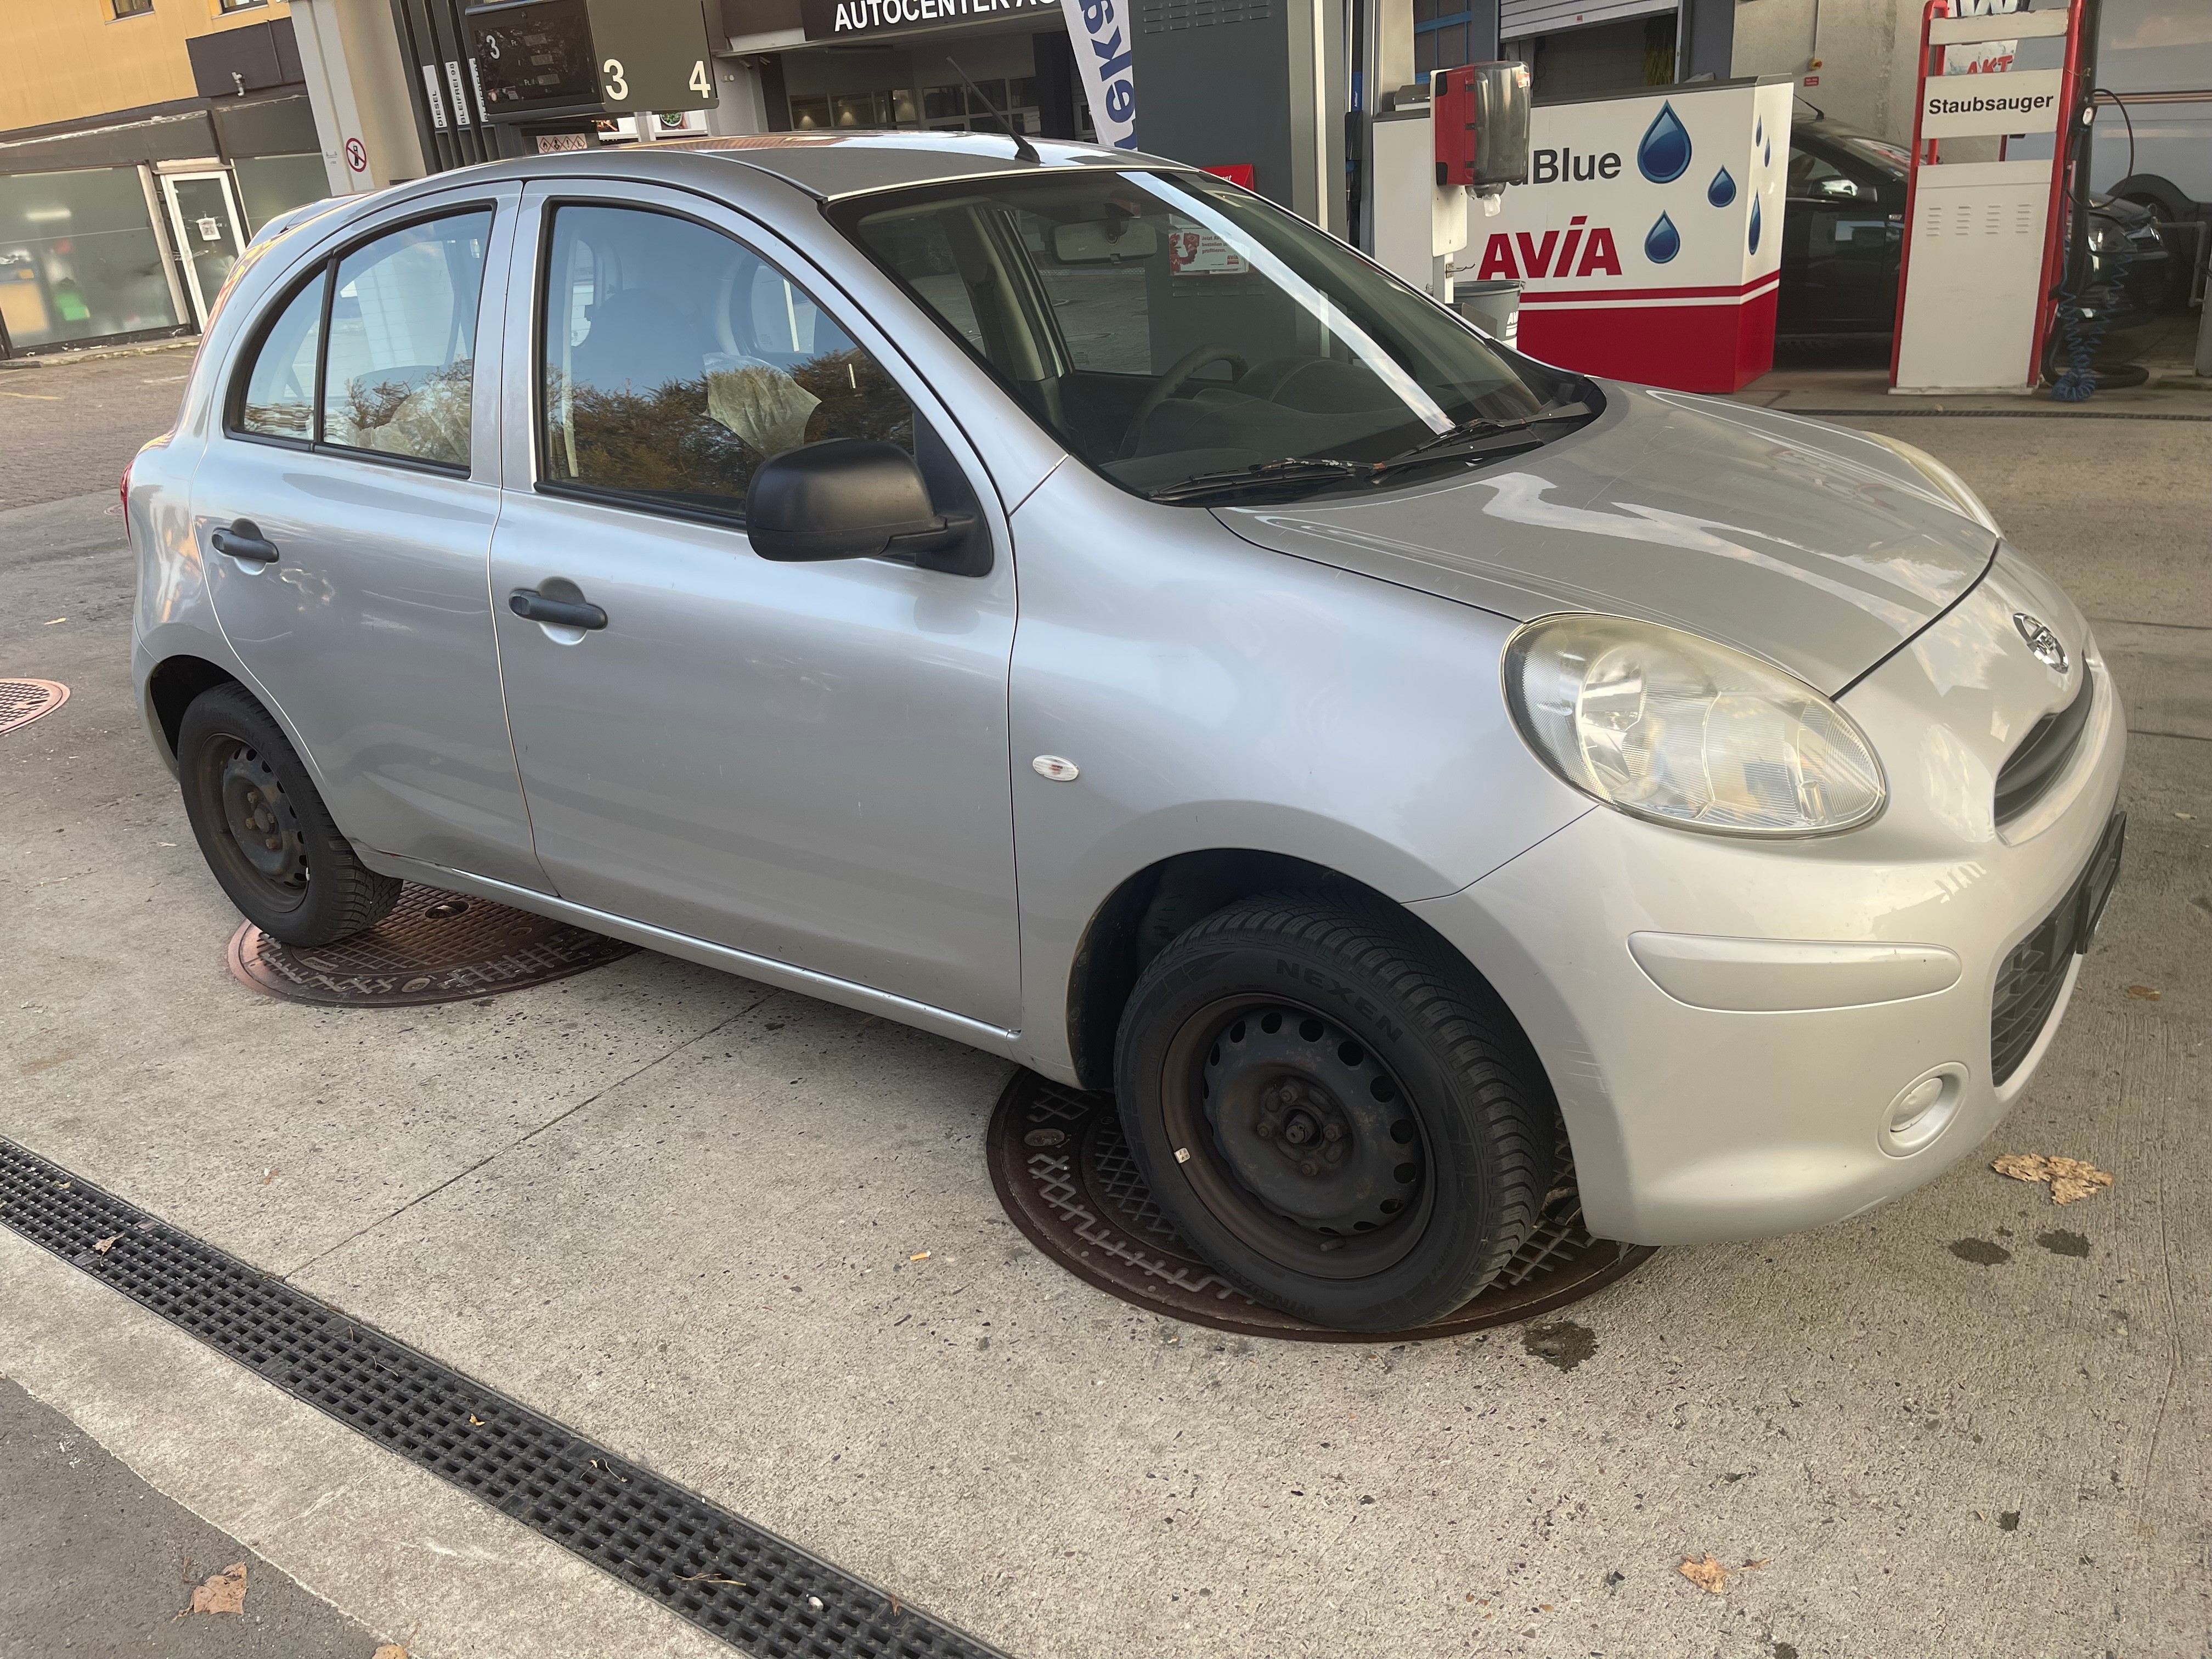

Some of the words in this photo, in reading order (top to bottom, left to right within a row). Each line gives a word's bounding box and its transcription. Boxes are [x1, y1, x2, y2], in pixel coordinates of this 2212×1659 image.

[486, 35, 500, 59] 3
[603, 59, 629, 100] 3
[689, 61, 711, 99] 4
[432, 89, 443, 126] DIESEL
[453, 78, 466, 123] BLEIFREI
[1928, 95, 2054, 114] Staubsauger
[1508, 147, 1622, 187] Blue
[1276, 959, 1403, 1043] NEXEN
